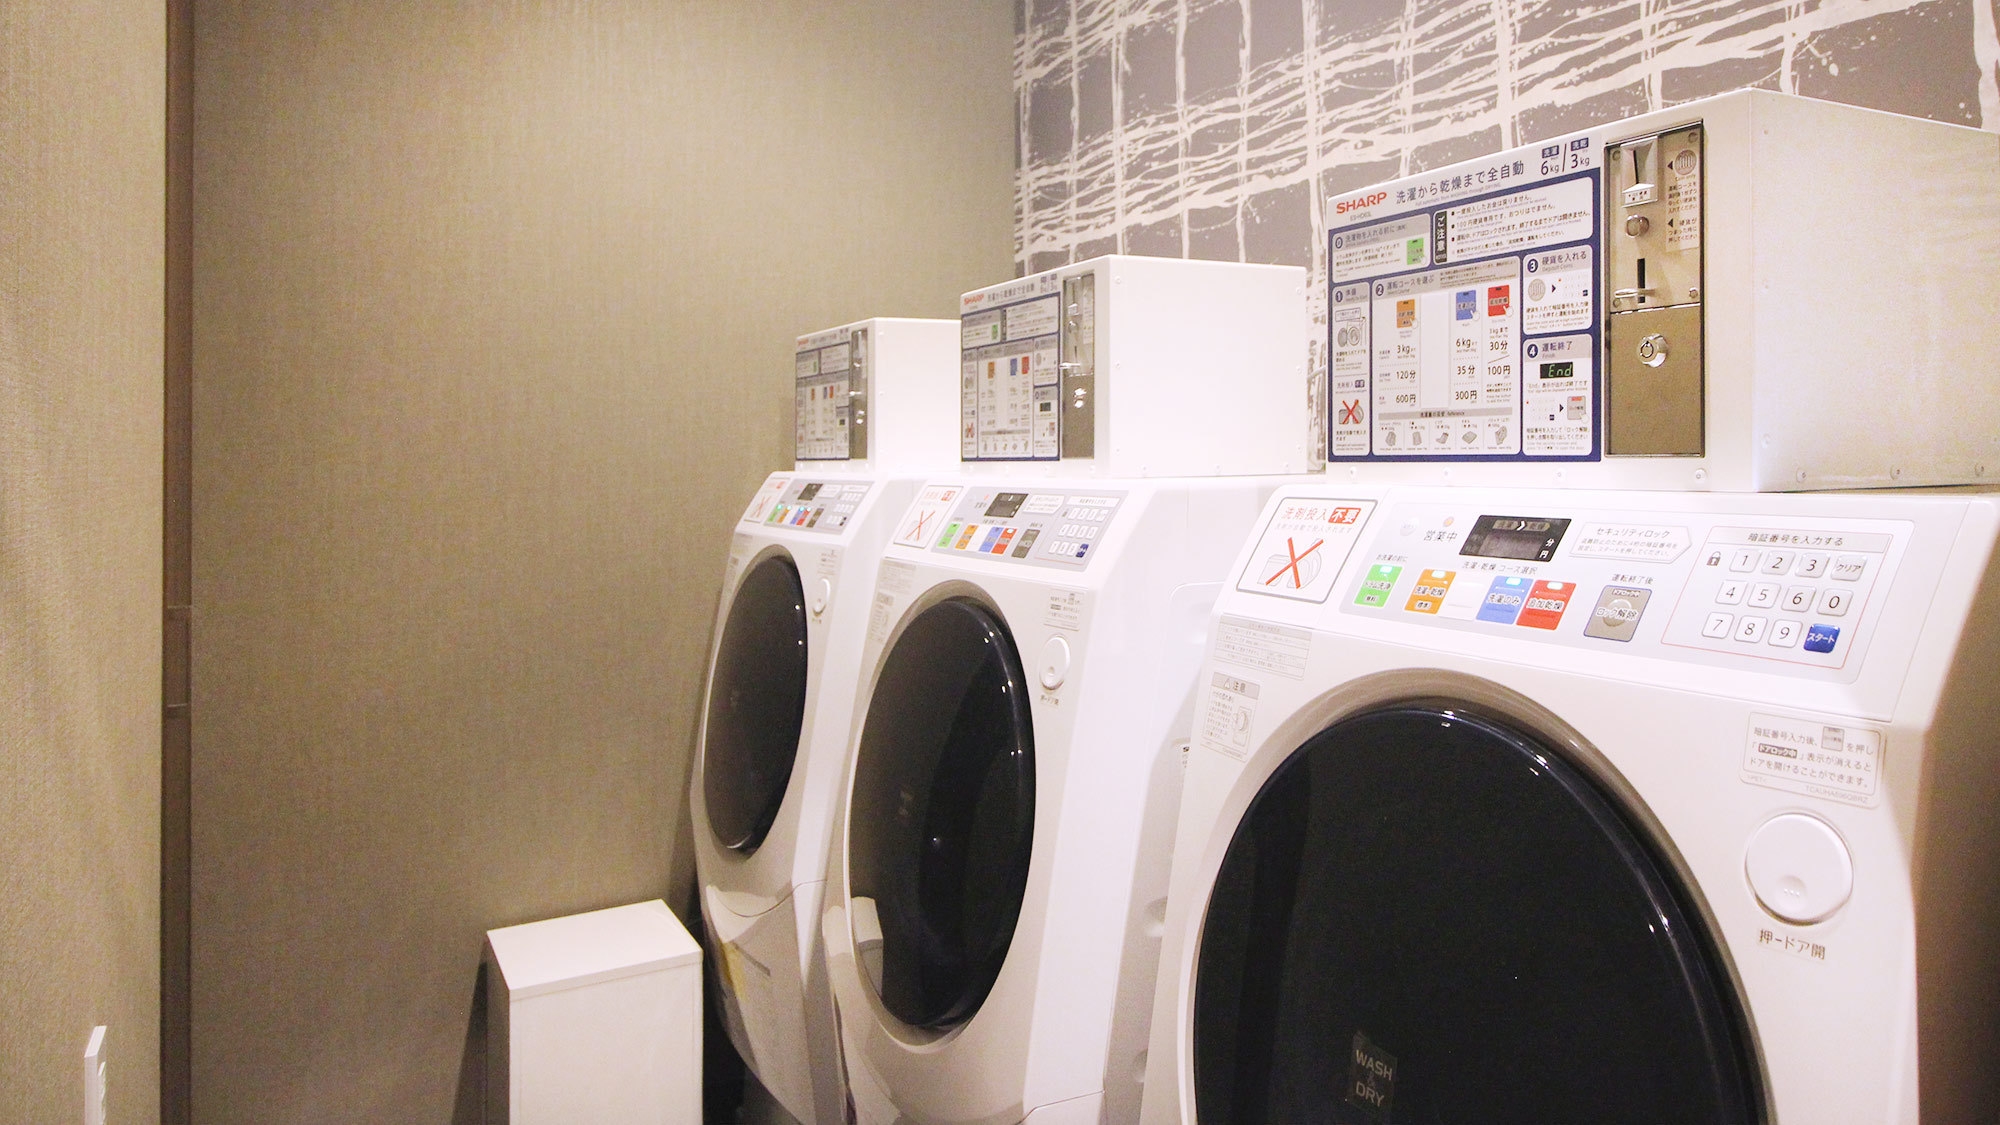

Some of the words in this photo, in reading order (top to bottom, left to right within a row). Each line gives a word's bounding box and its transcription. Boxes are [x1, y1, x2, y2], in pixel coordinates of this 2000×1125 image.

[1396, 160, 1525, 205] 洗濯から乾燥まで全自動
[1336, 191, 1387, 214] SHARP
[1436, 214, 1446, 252] ご注意
[1542, 251, 1587, 265] 硬貨を入れる
[1387, 276, 1435, 289] 運転コースを選ぶ
[1489, 341, 1508, 351] 30分
[1542, 341, 1572, 352] 運転終了
[1396, 370, 1416, 380] 120分
[1457, 365, 1475, 375] 35分
[1487, 365, 1511, 375] 100円
[1548, 363, 1572, 378] End
[1395, 394, 1416, 403] 600円
[1455, 390, 1477, 400] 300円
[1282, 507, 1327, 521] 洗剤投入
[1330, 508, 1360, 524] 不要
[1423, 530, 1457, 542] 営業中
[1597, 527, 1670, 538] セキュリティロック
[1545, 538, 1555, 547] 分
[1748, 533, 1843, 547] 暗証番号を入力する
[1539, 550, 1549, 559] 円
[1498, 565, 1538, 575] コース選択
[1772, 556, 1783, 569] 2
[1806, 559, 1817, 572] 3
[1836, 563, 1862, 573] クリア
[1611, 573, 1654, 585] 運転終了後
[1489, 593, 1521, 605] 洗濯のみ
[1726, 586, 1736, 598] 4
[1758, 588, 1769, 602] 5
[1792, 592, 1803, 605] 6
[1828, 595, 1840, 609] 0
[1527, 598, 1564, 611] 追加乾燥
[1597, 607, 1638, 620] ロック解除
[1712, 619, 1723, 632] 7
[1744, 622, 1755, 636] 8
[1780, 626, 1790, 640] 9
[1806, 631, 1836, 644] スタート
[1846, 742, 1874, 756] を押し
[1750, 756, 1868, 789] ドアを開けることができます。
[1356, 1049, 1393, 1081] WASH
[1356, 1081, 1384, 1107] DRY
